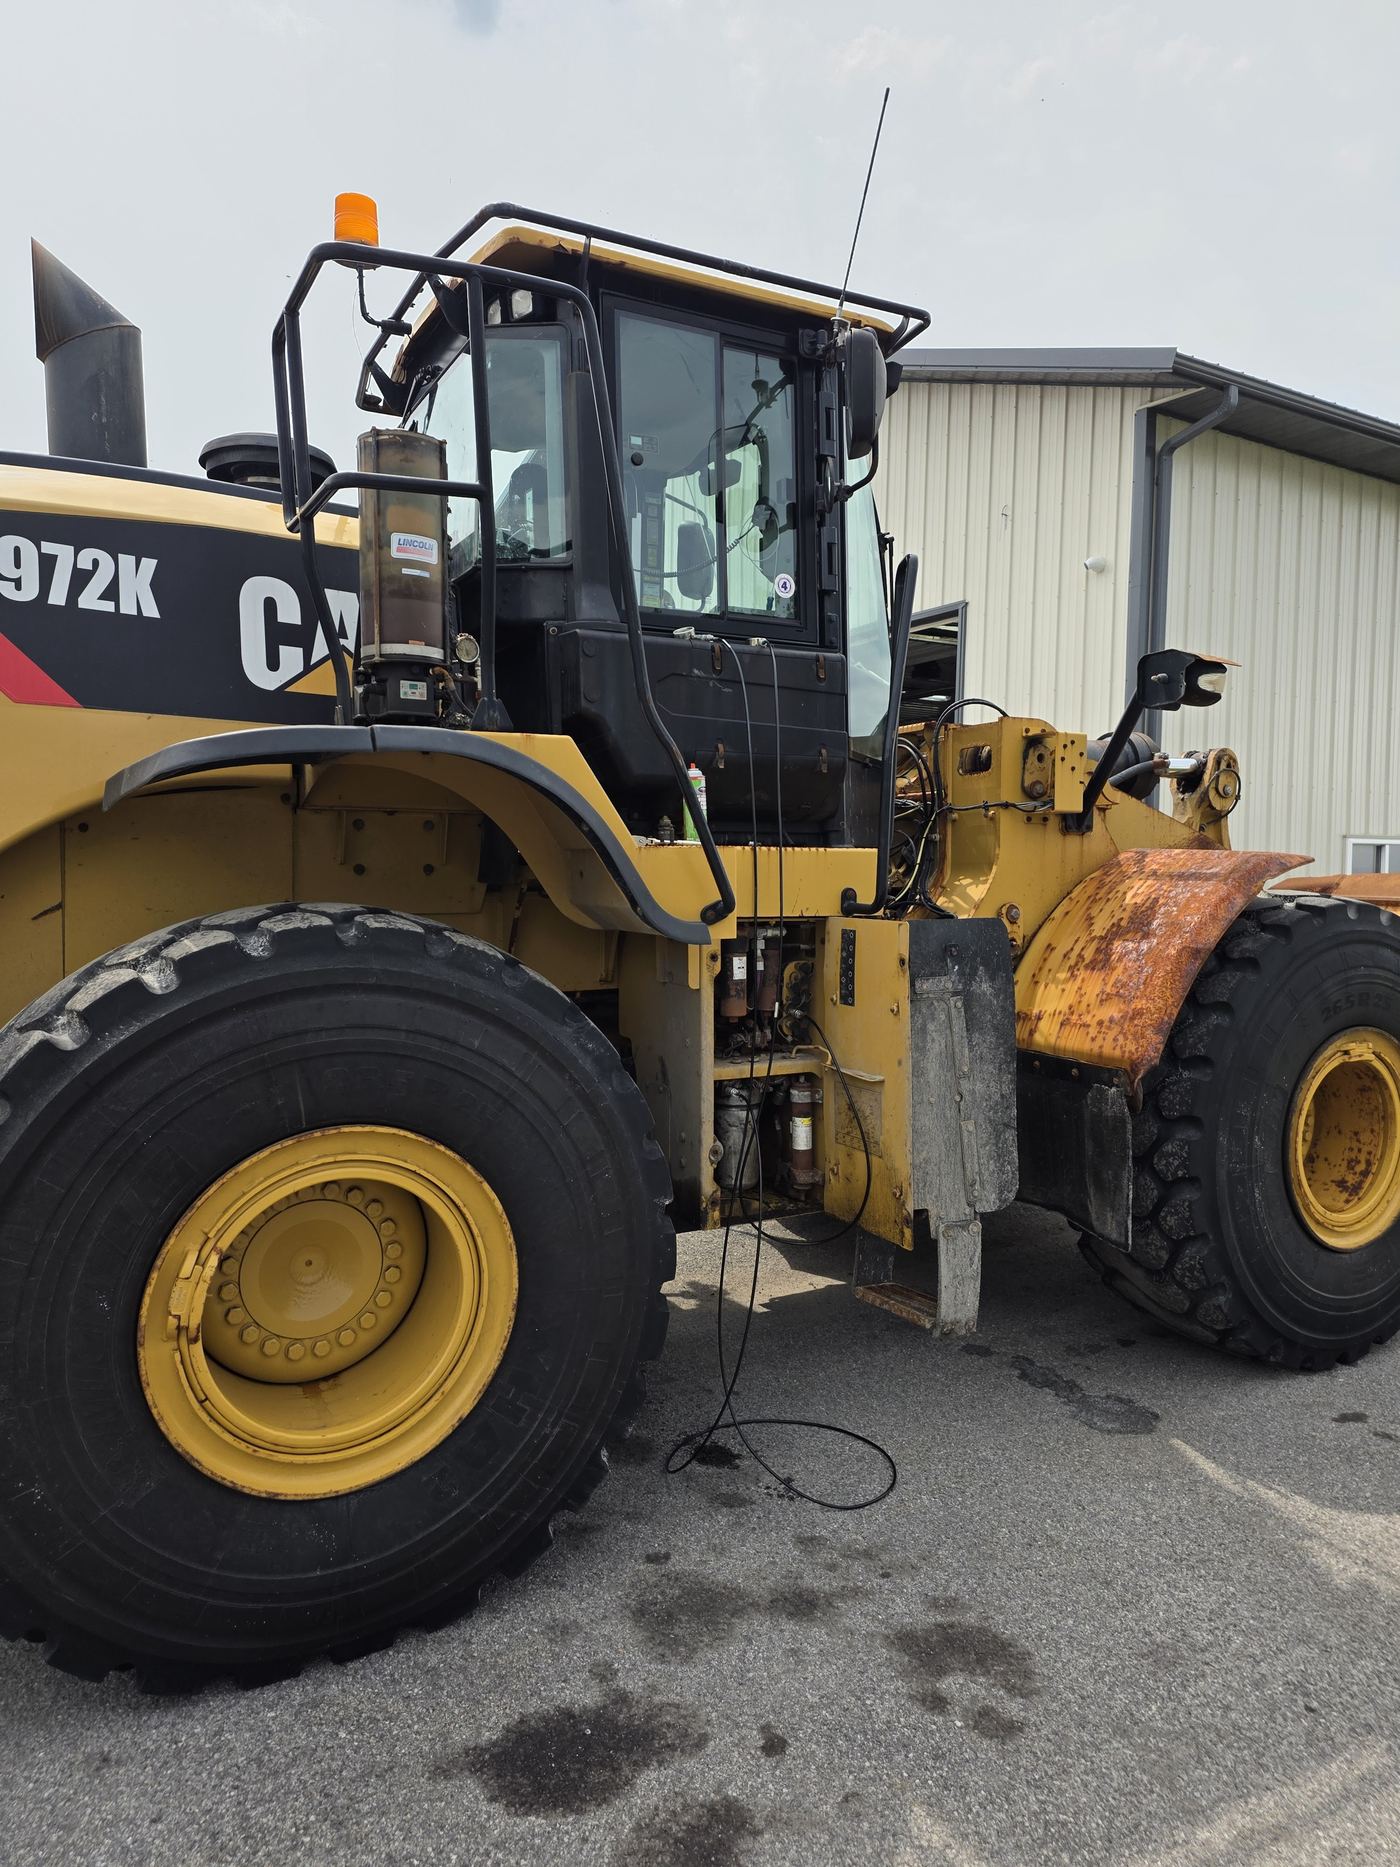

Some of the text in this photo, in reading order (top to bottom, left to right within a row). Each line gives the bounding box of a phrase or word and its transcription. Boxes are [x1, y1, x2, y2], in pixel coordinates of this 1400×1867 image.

[0, 535, 161, 618] 972K
[397, 538, 434, 551] LINCOLN
[239, 576, 360, 691] CA
